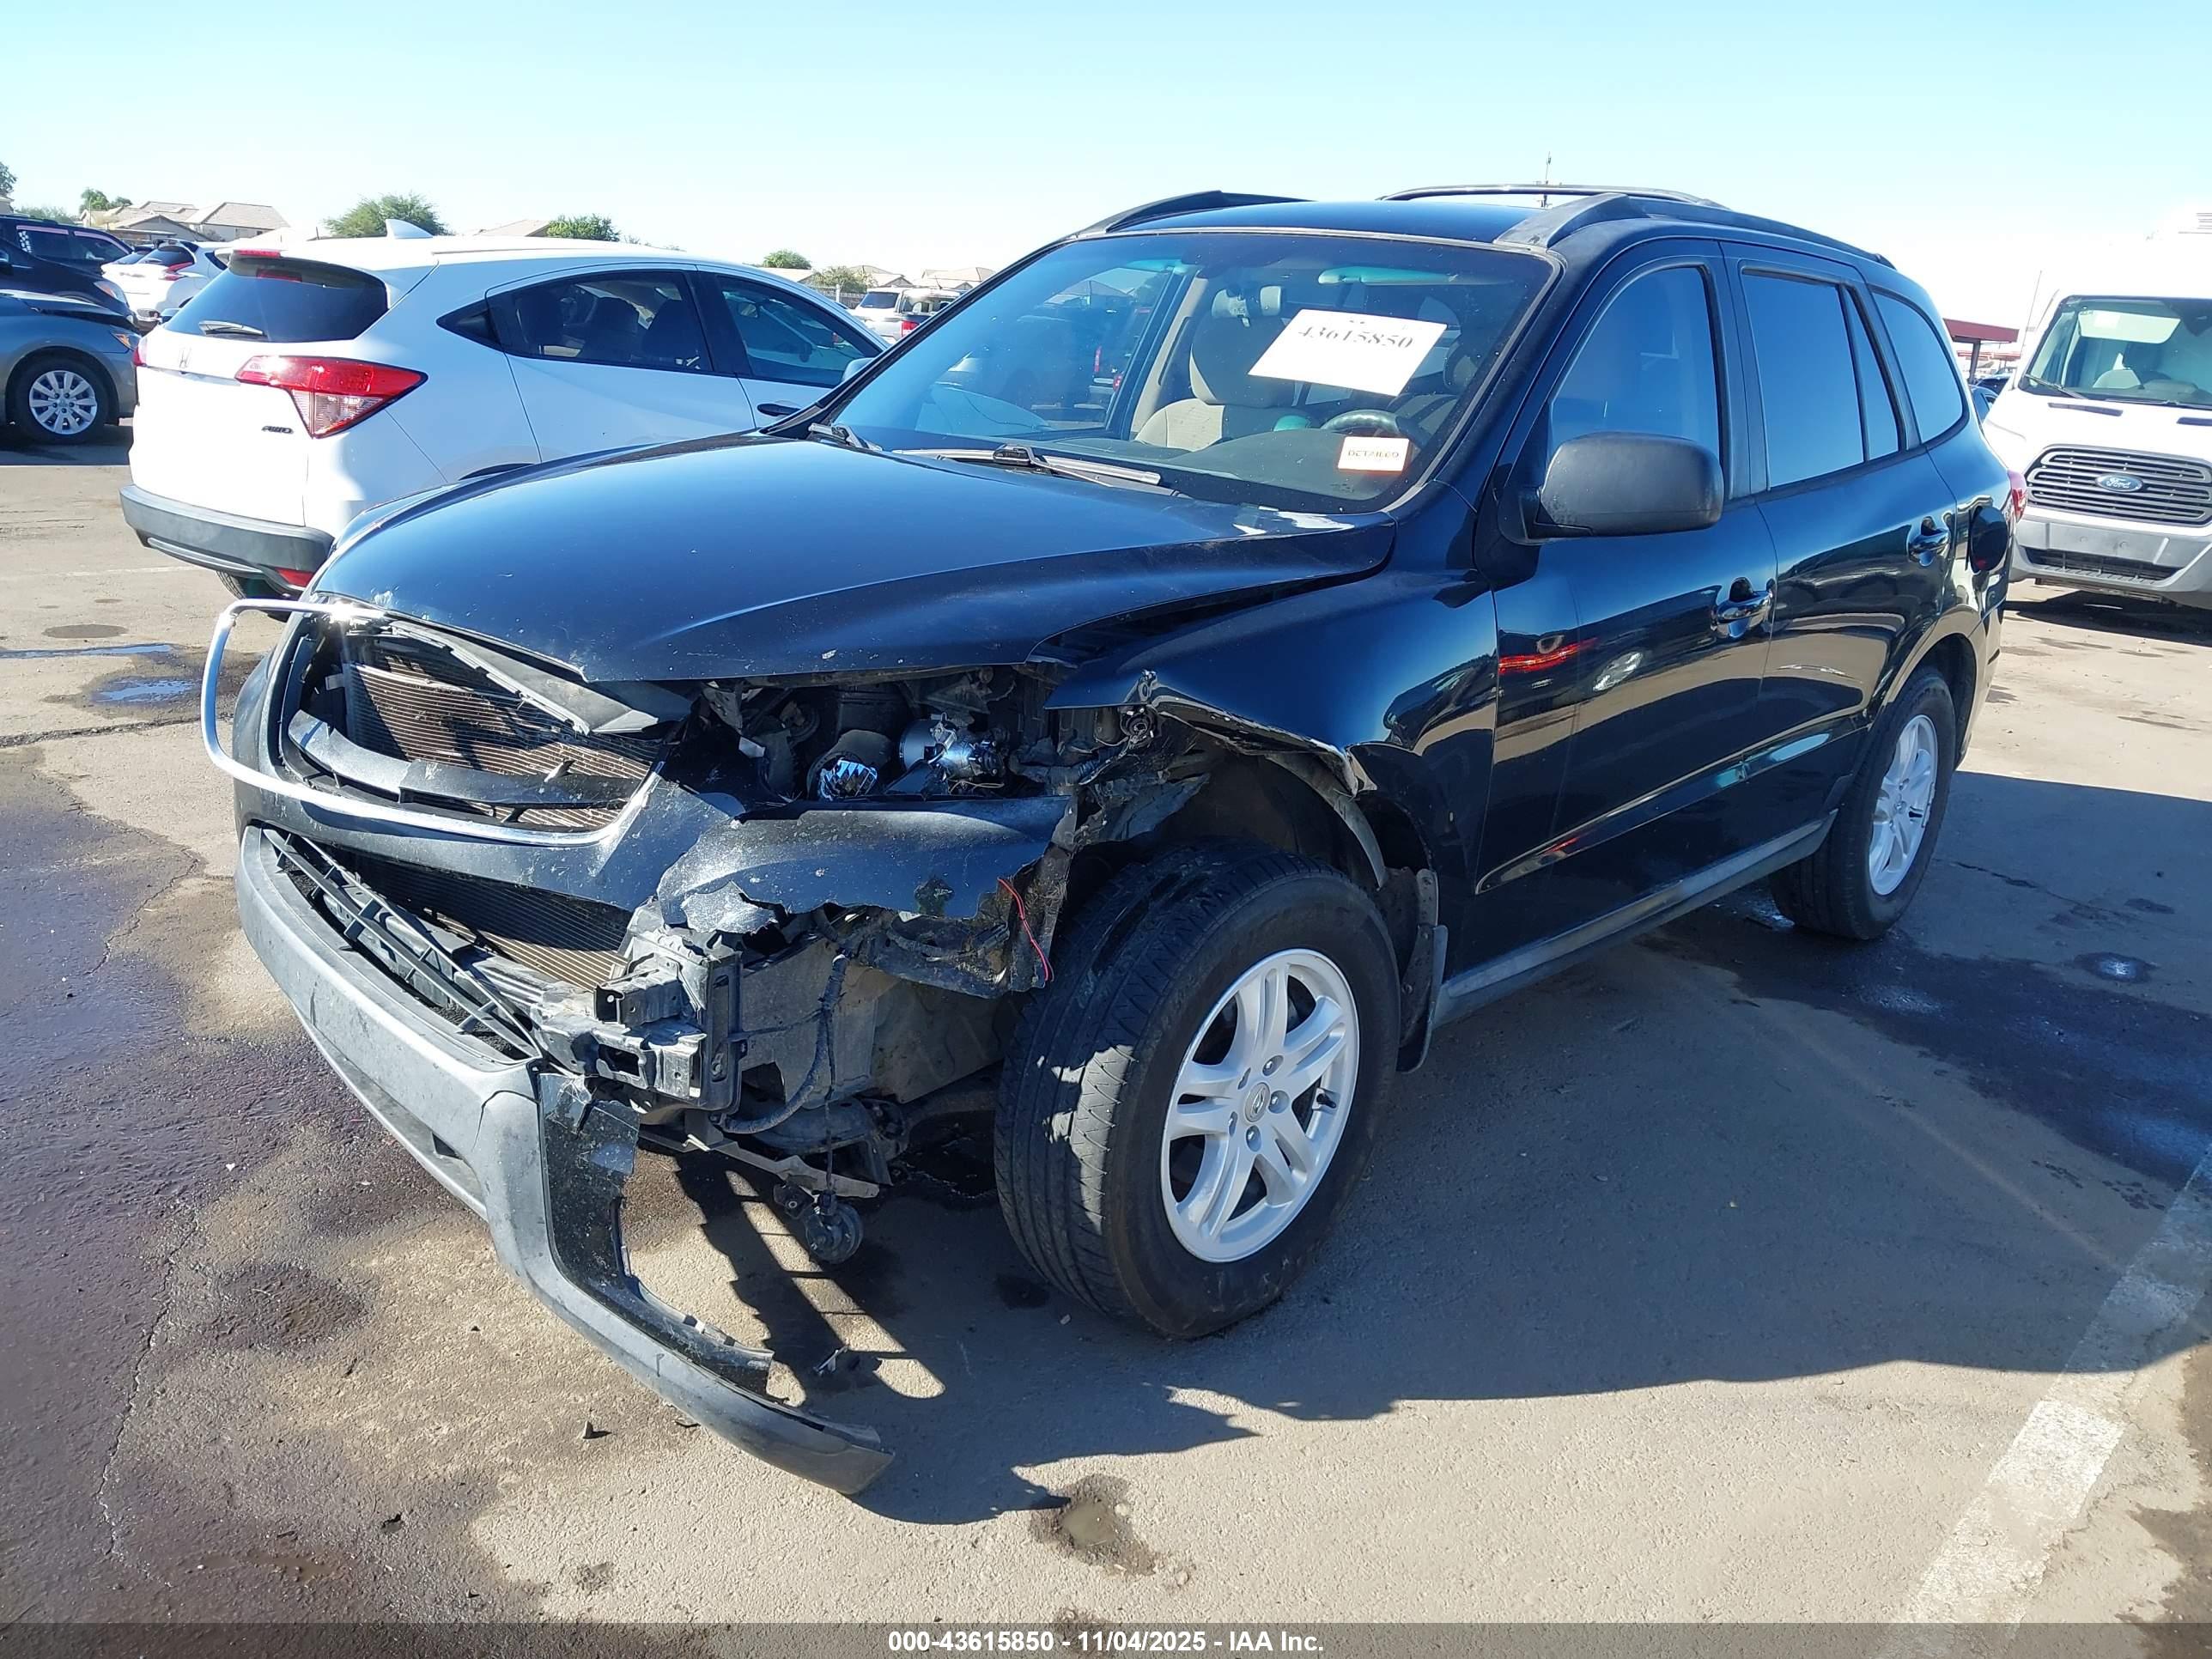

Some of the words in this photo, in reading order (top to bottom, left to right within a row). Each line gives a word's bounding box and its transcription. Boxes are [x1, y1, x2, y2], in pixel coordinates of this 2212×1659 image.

[1297, 326, 1414, 348] 43615850
[261, 426, 294, 434] AWD
[2106, 477, 2131, 489] Ford
